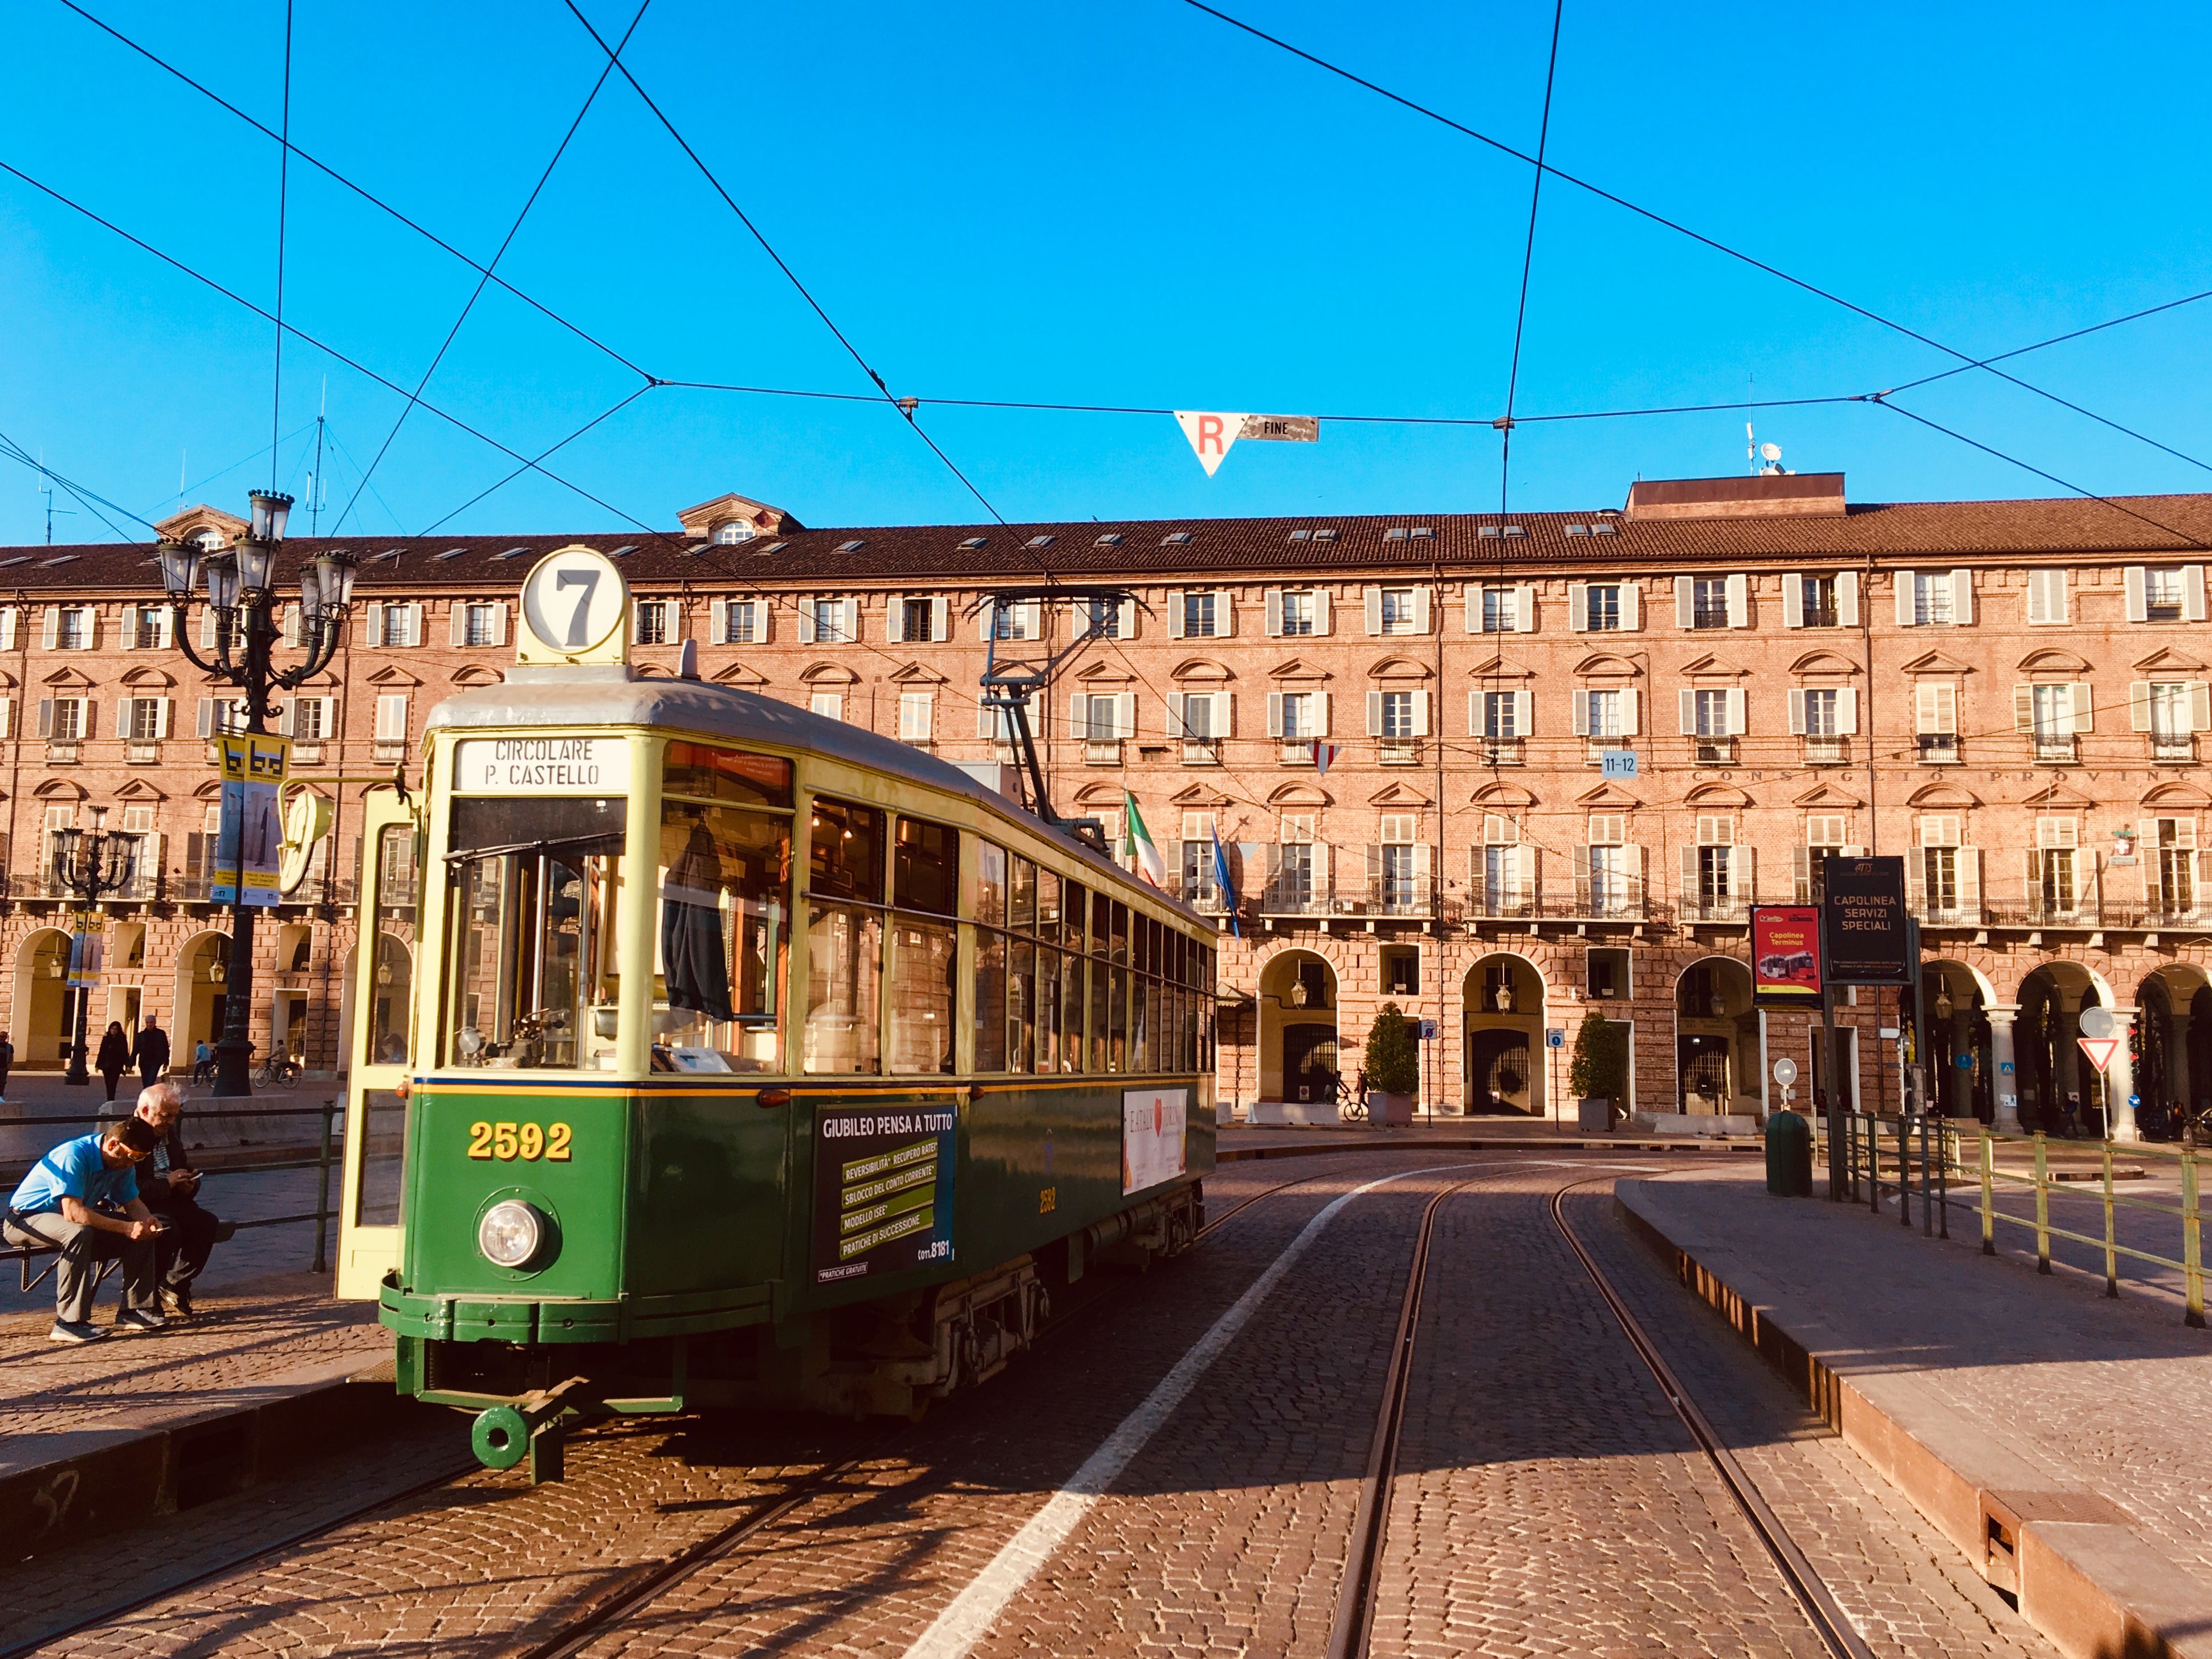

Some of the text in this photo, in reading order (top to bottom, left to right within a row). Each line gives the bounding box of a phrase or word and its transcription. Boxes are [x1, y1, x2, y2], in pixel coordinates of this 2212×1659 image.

[1199, 415, 1224, 455] R
[1264, 421, 1288, 435] FINE
[556, 569, 601, 646] 7
[495, 740, 593, 760] CIRCOLARE
[1605, 758, 1634, 771] 11-12
[486, 765, 599, 785] P. CASTELLO
[1990, 771, 2212, 781] PROVINC
[1834, 896, 1897, 905] CAPOLINEA
[1845, 908, 1887, 918] SERVIZI
[1842, 921, 1891, 930] SPECIALI
[823, 1113, 952, 1138] GIUBILEO PENSA A TUTTO
[467, 1122, 572, 1161] 2592
[893, 1146, 920, 1165] RECUPERO
[845, 1186, 873, 1205] SBLOCCO
[874, 1184, 885, 1195] DEL
[886, 1176, 904, 1191] CONTO
[844, 1210, 873, 1230] MODELLO
[843, 1214, 920, 1256] PRATICHE DI SUCCESSIONE
[846, 1263, 867, 1275] GRATUITE
